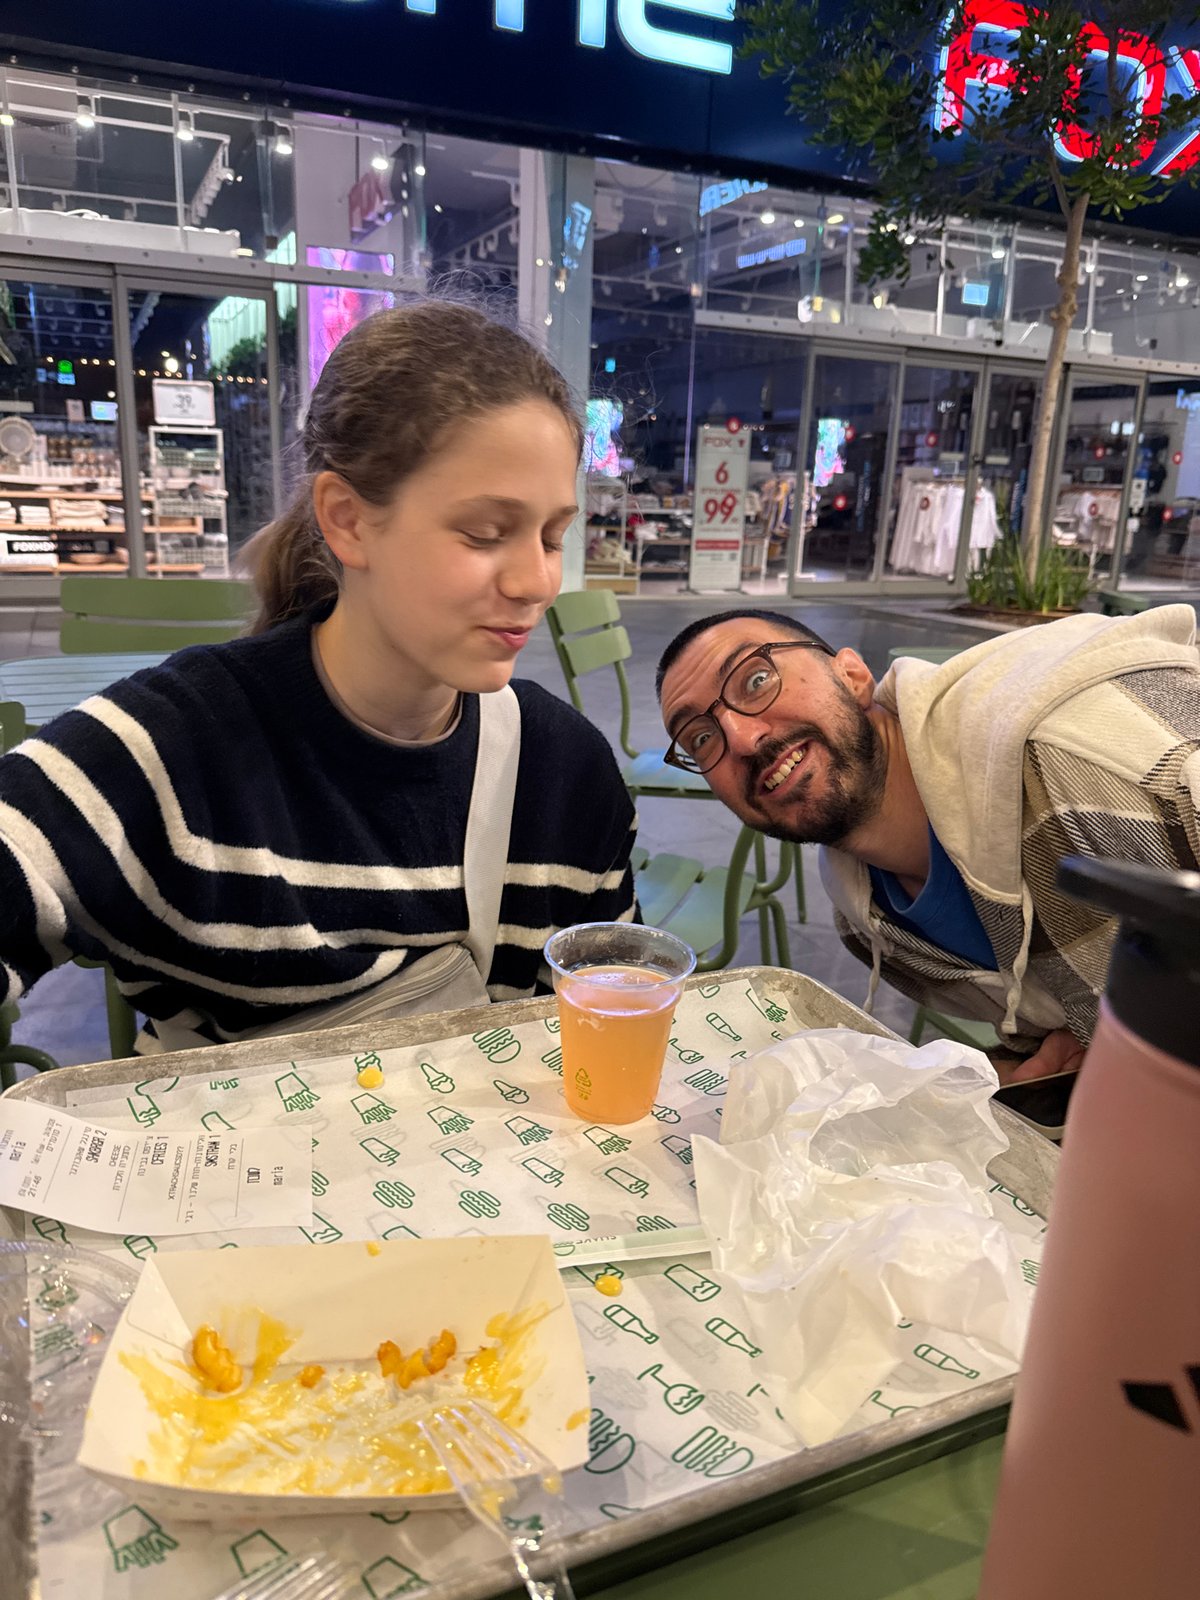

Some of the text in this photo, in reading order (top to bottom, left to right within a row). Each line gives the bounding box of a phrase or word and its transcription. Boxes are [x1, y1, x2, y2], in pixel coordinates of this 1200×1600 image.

[715, 461, 729, 485] 6
[704, 498, 735, 525] 99
[9, 1141, 26, 1161] maria
[109, 1144, 121, 1167] CHEESE
[151, 1142, 168, 1165] CFRIES
[271, 1166, 283, 1186] maria
